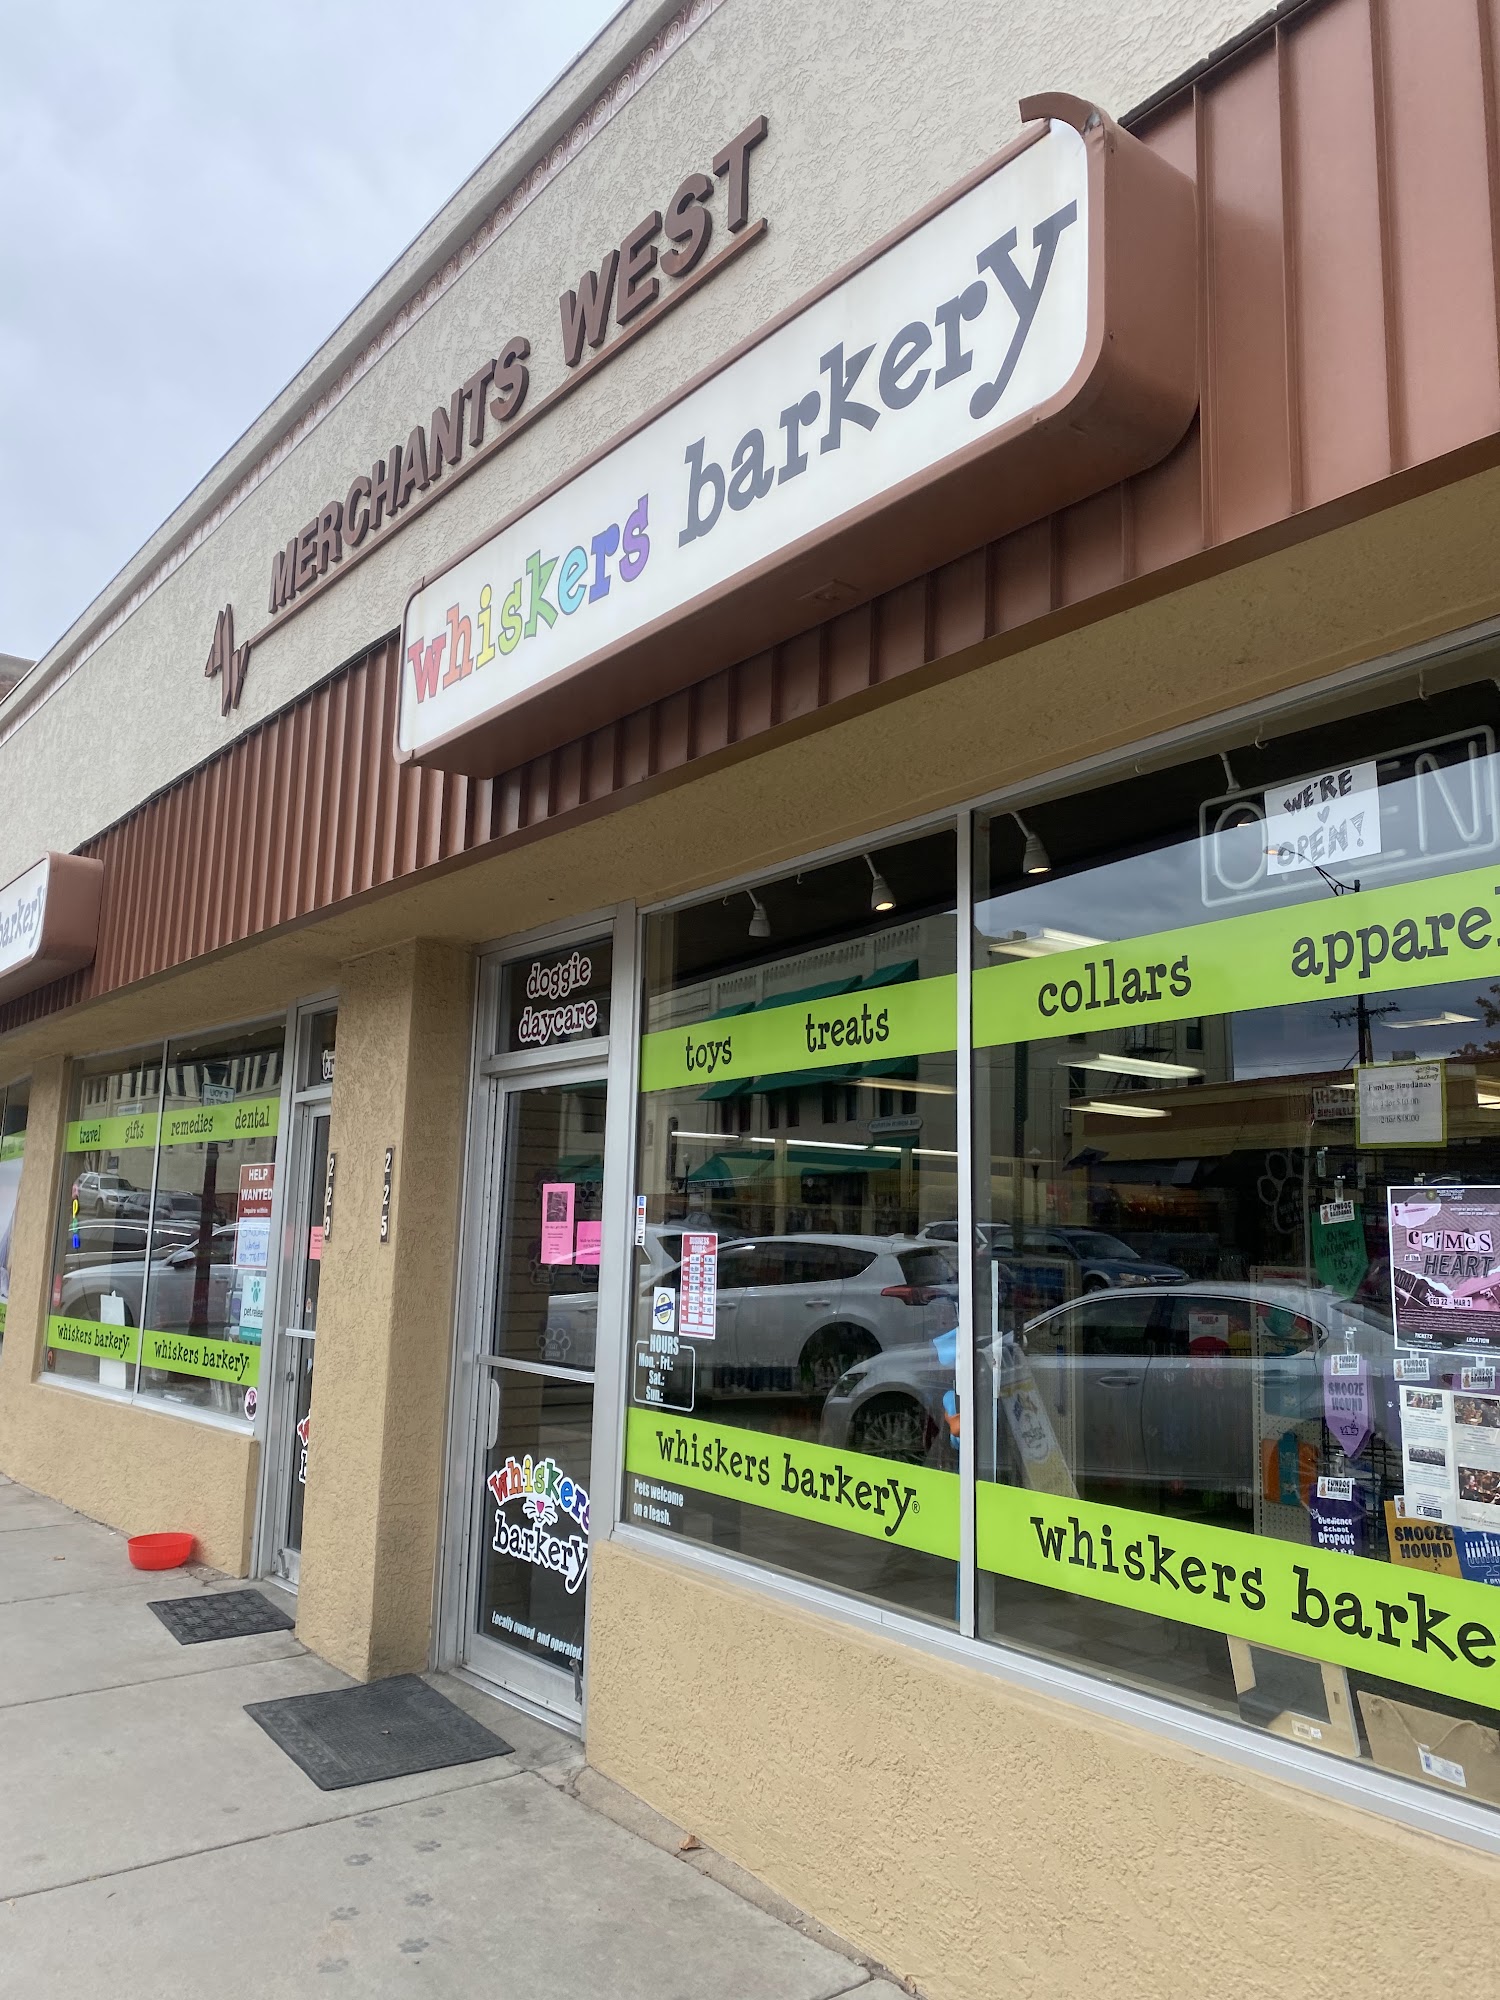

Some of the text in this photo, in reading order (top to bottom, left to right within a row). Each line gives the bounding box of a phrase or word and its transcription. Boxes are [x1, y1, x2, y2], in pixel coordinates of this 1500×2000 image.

[268, 115, 769, 613] MERCHANTS WEST
[407, 199, 1078, 704] whiskers barkery
[1283, 769, 1353, 816] WE'RE
[1277, 811, 1365, 867] OPEN!
[0, 885, 46, 949] arkery
[1291, 885, 1500, 985] appare
[527, 951, 592, 1000] doggie
[1038, 955, 1192, 1017] collars
[519, 999, 597, 1045] daycare
[806, 1003, 890, 1052] treats
[686, 1036, 732, 1073] toys
[79, 1120, 145, 1144] travel gifts
[171, 1105, 270, 1136] remedies dental
[248, 1168, 268, 1181] HELP
[241, 1189, 273, 1201] WANTED
[324, 1157, 336, 1236] 223
[380, 1152, 392, 1236] 225
[1423, 1254, 1495, 1277] HEART
[57, 1323, 92, 1344] whiskers
[650, 1334, 679, 1355] HOURS
[154, 1340, 199, 1364] whiskers
[639, 1352, 655, 1368] Mon.
[1328, 1382, 1365, 1396] SNOOZE
[1332, 1397, 1363, 1411] HOUND
[656, 1429, 769, 1486] whiskers
[634, 1478, 684, 1507] Pets welcome
[1328, 1479, 1350, 1488] FUNDOG
[633, 1505, 671, 1526] on a leash.
[1318, 1516, 1352, 1526] Obedience
[1318, 1531, 1355, 1545] Dropout
[1394, 1525, 1453, 1541] SNOOZE
[493, 1509, 589, 1594] barkery
[1029, 1516, 1266, 1611] whiskers
[1400, 1542, 1453, 1558] HOUND
[492, 1610, 583, 1661] Locally owned and operated.
